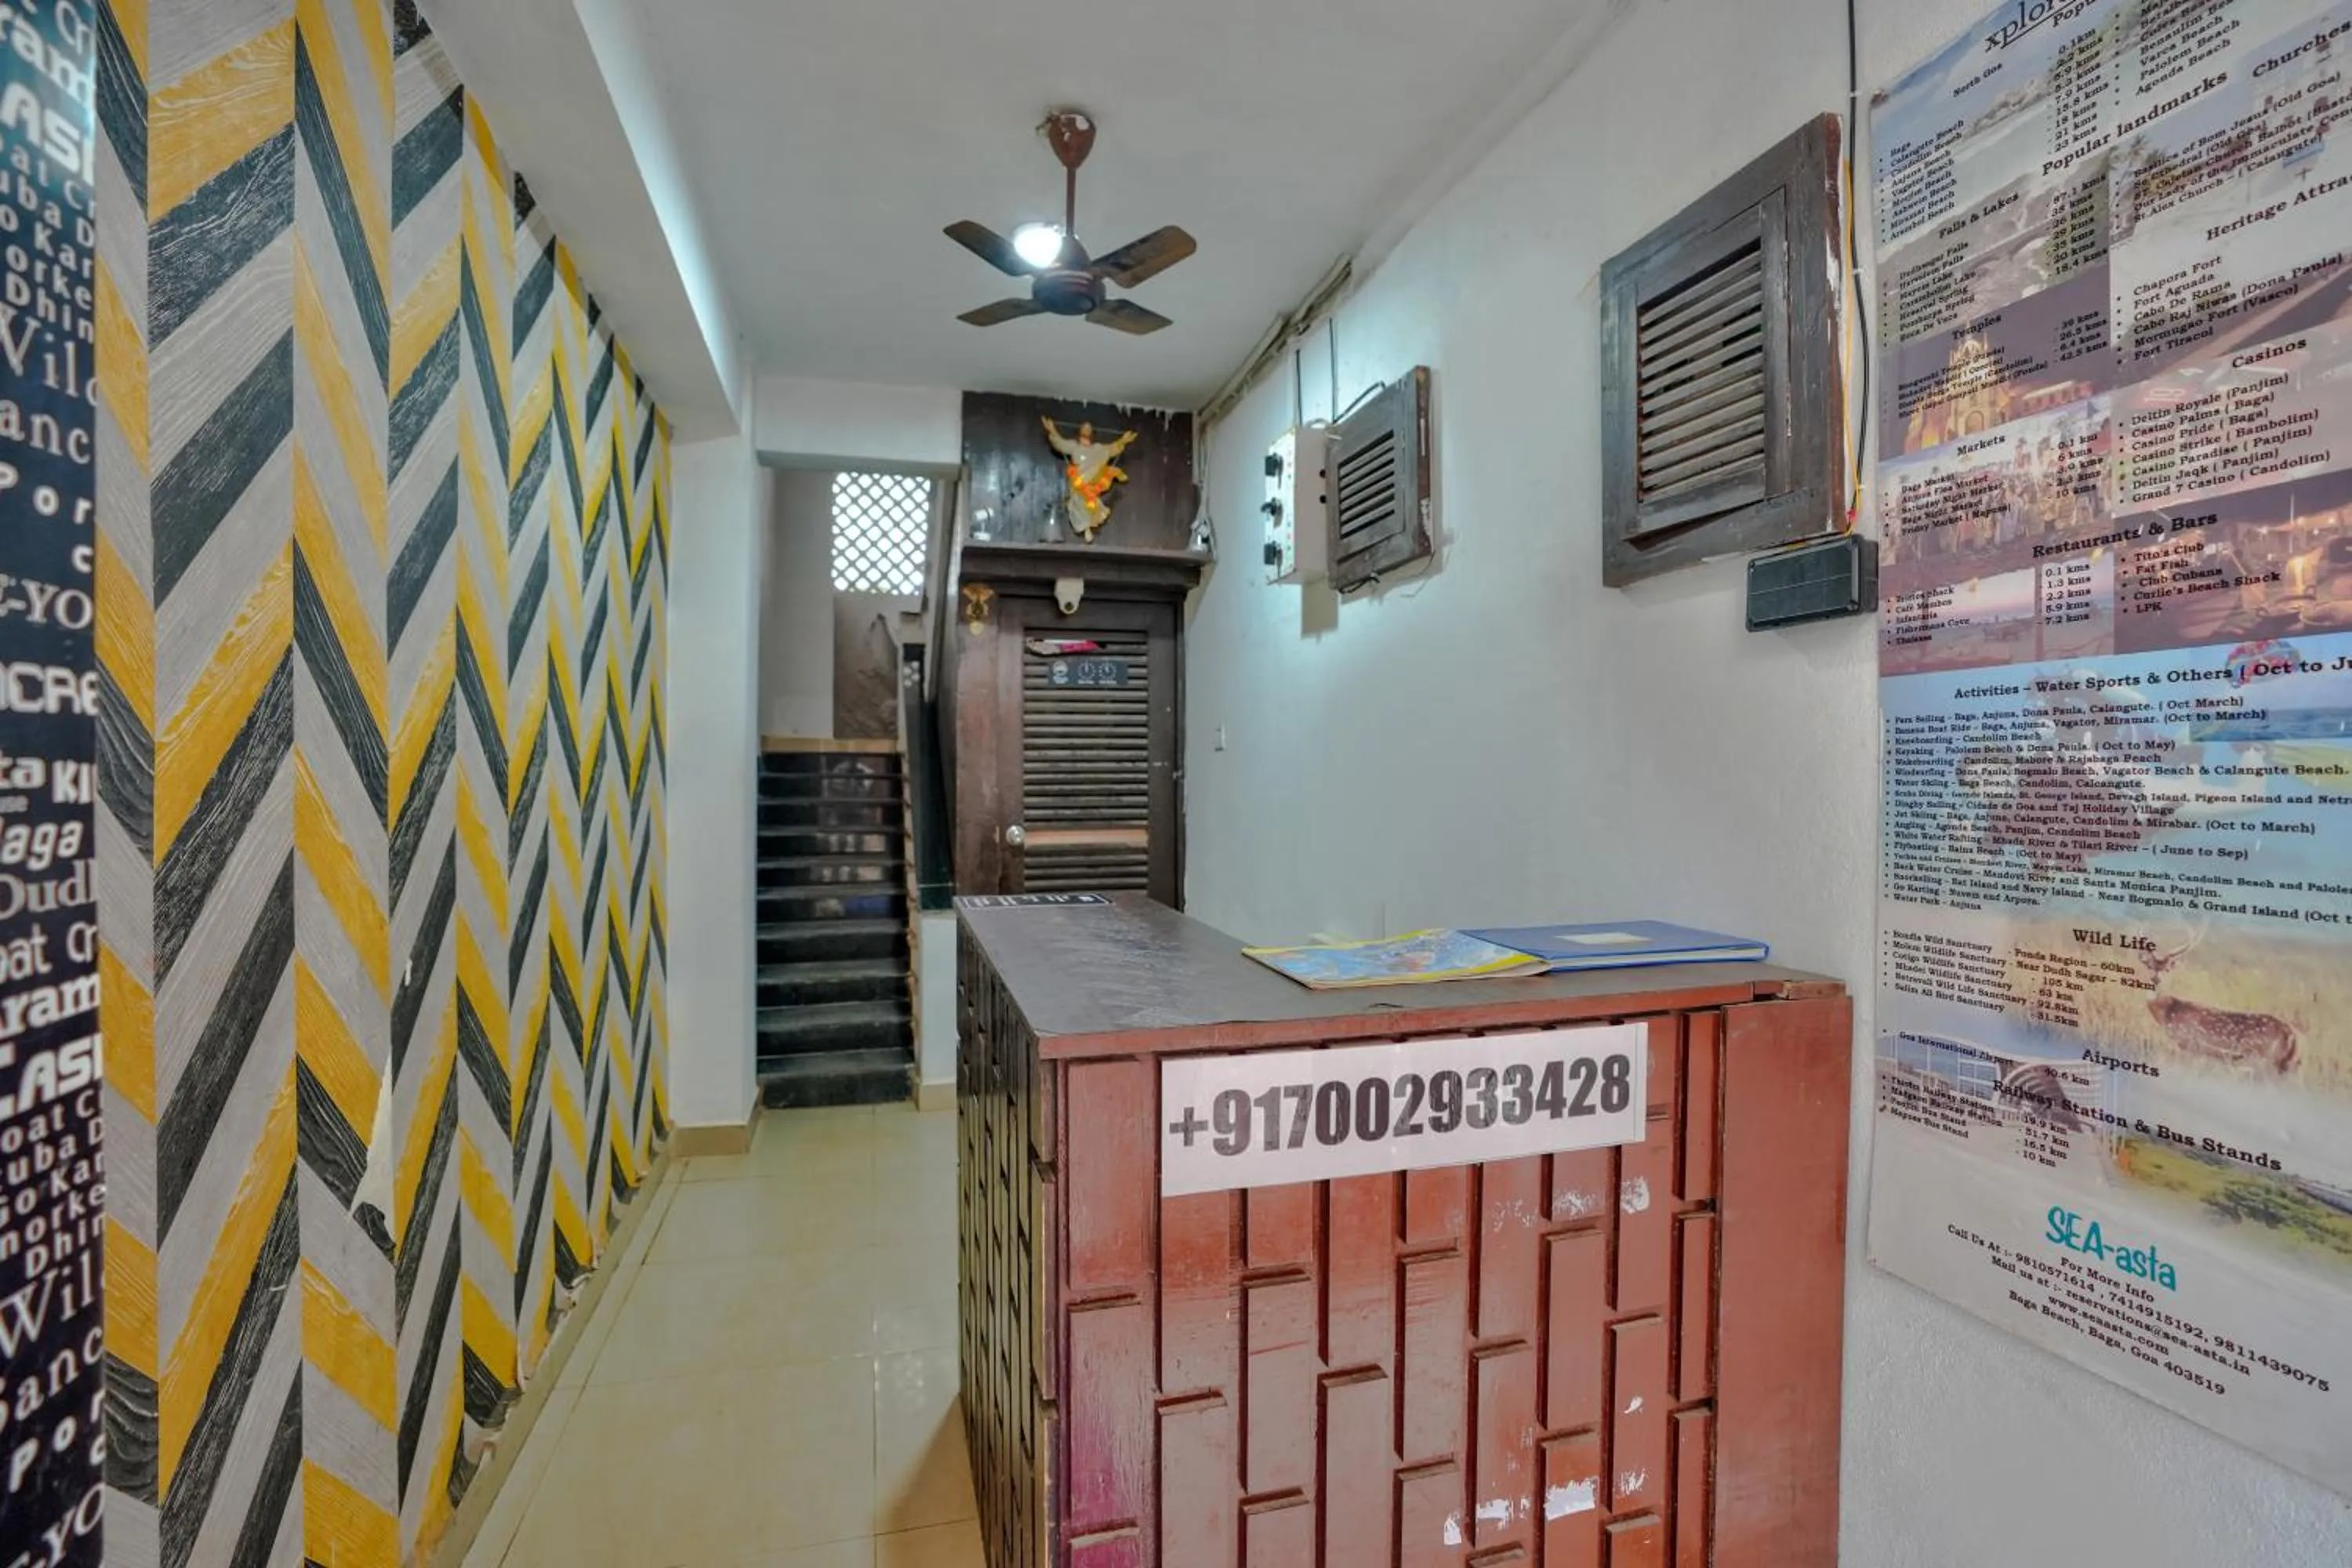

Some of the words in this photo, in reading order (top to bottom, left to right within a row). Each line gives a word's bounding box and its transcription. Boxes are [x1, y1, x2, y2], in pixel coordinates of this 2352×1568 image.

[2140, 44, 2176, 67] Varca
[2182, 16, 2223, 43] Beach
[2140, 47, 2192, 81] Palolem
[2197, 20, 2240, 49] Beach
[2252, 20, 2351, 78] Churches
[2135, 65, 2183, 96] Agonda
[2188, 39, 2231, 67] Beach
[2042, 131, 2111, 176] Popular
[2116, 71, 2229, 138] landmarks
[2073, 125, 2097, 143] kms
[1939, 216, 1966, 239] Falls
[1983, 194, 2020, 217] Lakes
[2206, 201, 2287, 241] Heritage
[2293, 174, 2352, 205] Attra
[2133, 270, 2187, 296] Chapora
[2192, 256, 2222, 274] Fort
[2133, 292, 2160, 310] Fort
[2165, 274, 2216, 298] Aguada
[2133, 318, 2165, 335] Cabo
[2170, 307, 2192, 325] Raj
[2196, 292, 2237, 313] Niwas
[2241, 275, 2286, 298] (Dona
[2292, 253, 2343, 278] Paula)
[1951, 314, 2002, 340] Temples
[2134, 317, 2203, 348] Mormugao
[2208, 305, 2238, 321] Fort
[2243, 284, 2299, 312] (Vasco)
[2134, 345, 2161, 361] Fort
[2165, 326, 2214, 350] Tiracol
[2232, 338, 2307, 368] Casinos
[2132, 407, 2171, 426] Deltin
[2176, 393, 2221, 414] Royale
[2227, 372, 2289, 401] (Panjim)
[2132, 419, 2175, 438] Casino
[2180, 408, 2220, 426] Palms
[2132, 447, 2175, 464] Casino
[2180, 434, 2221, 452] Strike
[2236, 409, 2319, 437] Bambolim)
[1957, 434, 2005, 456] Markets
[2132, 474, 2171, 490] Deltin
[2223, 448, 2279, 470] Panjim)
[2132, 487, 2171, 503] Grand
[2187, 474, 2235, 490] Casino
[2249, 450, 2331, 476] Candolim)
[2032, 527, 2140, 558] Restaurants
[2148, 521, 2164, 535] &
[2171, 513, 2219, 532] Bars
[2134, 548, 2169, 562] Tito's
[2174, 542, 2204, 556] Club
[2134, 586, 2183, 601] Curlie's
[2187, 581, 2229, 594] Beach
[2234, 572, 2281, 587] Shack
[2136, 564, 2157, 575] Fat
[2161, 557, 2188, 570] Fish
[2140, 575, 2168, 587] Club
[2172, 568, 2223, 582] Cubana
[2067, 588, 2091, 599] kms
[2136, 602, 2162, 614] LPK
[1954, 686, 2020, 699] Activities
[2035, 681, 2080, 693] Water
[2085, 676, 2140, 691] Sports
[2147, 673, 2161, 684] &
[2167, 668, 2233, 684] Others
[2254, 662, 2290, 676] Oct
[2299, 658, 2322, 672] to
[2103, 766, 2151, 776] Vagator
[2154, 765, 2194, 775] Beach
[2214, 765, 2288, 777] Calangute
[2295, 765, 2350, 775] Beach.
[2016, 802, 2036, 811] Goa
[2063, 804, 2078, 814] Taj
[2083, 804, 2128, 815] Holiday
[2132, 805, 2175, 815] Village
[2206, 819, 2236, 830] (Oct
[2241, 822, 2256, 831] to
[2261, 822, 2316, 835] March)
[0, 817, 83, 870] aga
[2159, 845, 2194, 856] June
[2198, 847, 2212, 857] to
[2217, 848, 2249, 861] Sep)
[2120, 880, 2165, 894] Monica
[2169, 885, 2222, 899] Panjim.
[2204, 900, 2247, 915] Grand
[2252, 905, 2299, 920] Island
[2304, 909, 2338, 924] (Oct
[2014, 948, 2046, 961] Ponda
[2049, 952, 2088, 968] Region
[2072, 928, 2113, 946] Wild
[2118, 935, 2157, 953] Life
[2016, 960, 2039, 972] Near
[2042, 965, 2071, 977] Dudh
[2075, 970, 2107, 984] Sagar
[0, 973, 100, 1039] ram
[2082, 1048, 2160, 1077] Airports
[1169, 1054, 1632, 1157] +917002933428
[1992, 1079, 2053, 1110] Railway
[2063, 1099, 2129, 1127] Station
[2135, 1119, 2150, 1134] &
[2157, 1124, 2195, 1148] Bus
[2202, 1137, 2282, 1172] Stands
[2045, 1204, 2177, 1292] SEA-asta
[2060, 1257, 2082, 1274] For
[2087, 1266, 2121, 1289] More
[2125, 1283, 2155, 1303] Info
[1947, 1224, 1969, 1240] Call
[1971, 1233, 1985, 1247] Us
[1987, 1241, 2002, 1253] At
[2016, 1252, 2096, 1293] 9810571614
[2213, 1334, 2331, 1393] 9811439075
[1991, 1255, 2016, 1273] Mail
[2020, 1271, 2034, 1282] us
[2037, 1275, 2051, 1288] at
[2066, 1288, 2250, 1377] reservations@sea-asta.in
[2048, 1294, 2169, 1356] www.seaasta.com
[2009, 1290, 2037, 1312] Baga
[2042, 1303, 2085, 1333] Beach,
[2089, 1326, 2126, 1353] Baga,
[2130, 1346, 2159, 1367] Goa
[2163, 1361, 2225, 1396] 403519
